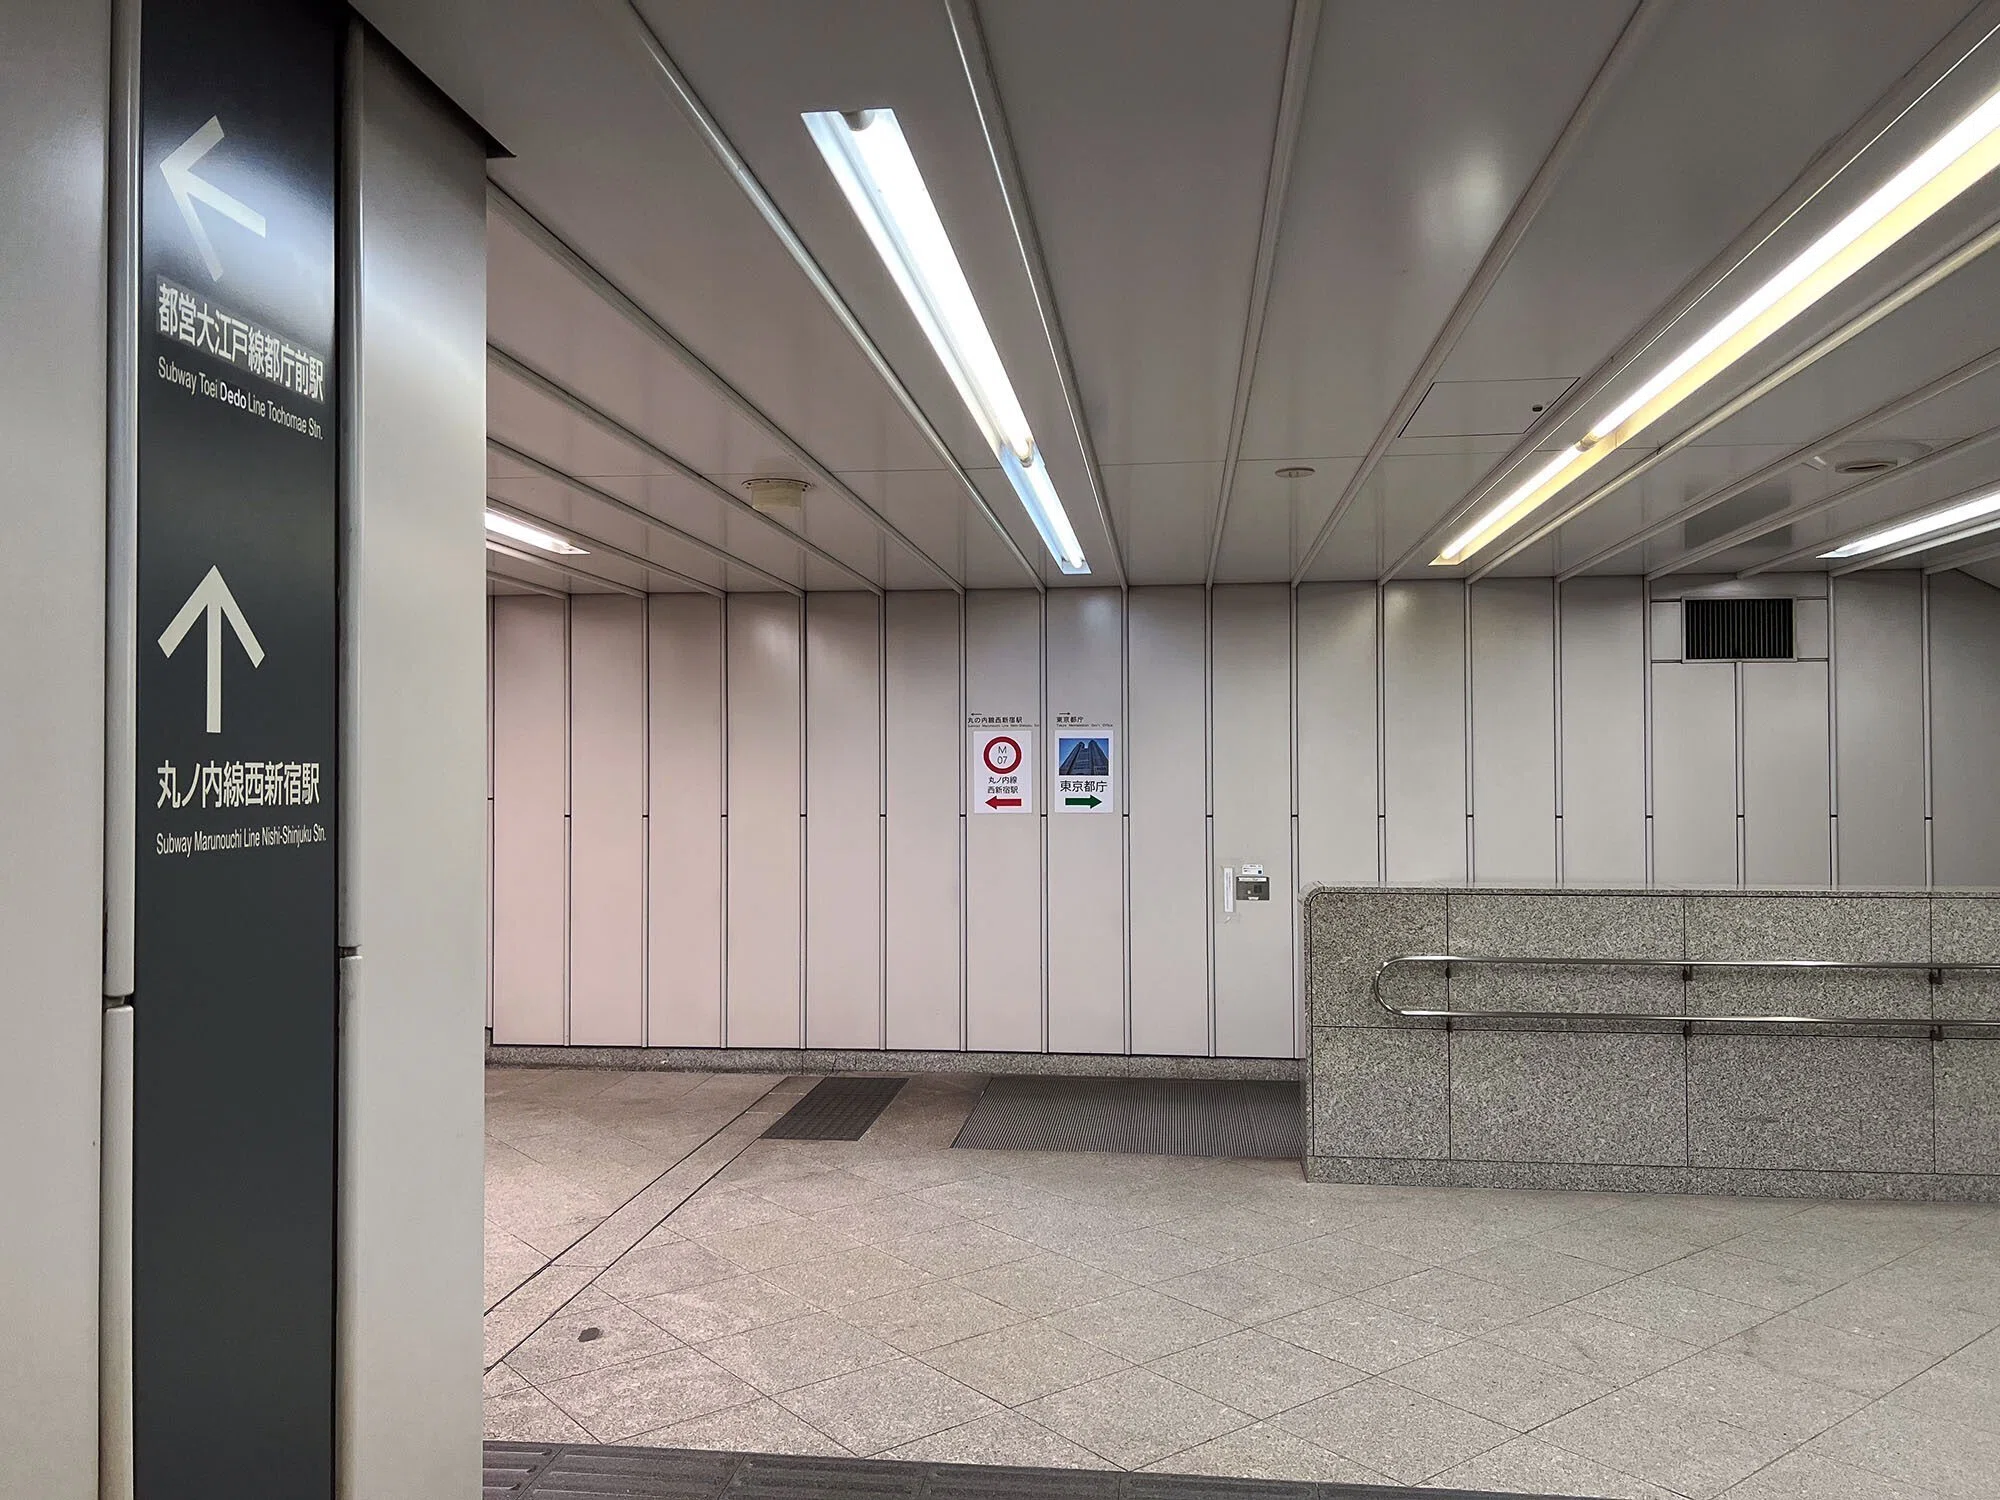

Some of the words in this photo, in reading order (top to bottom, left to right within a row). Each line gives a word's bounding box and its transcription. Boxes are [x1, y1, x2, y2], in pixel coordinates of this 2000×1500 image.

[158, 283, 324, 401] 都営大江戸線都庁前駅
[158, 356, 197, 395] Subway
[199, 372, 218, 398] Toei
[248, 392, 266, 417] Line
[267, 400, 307, 433] Tochomae
[308, 417, 324, 440] Stn.
[998, 746, 1007, 754] M
[997, 755, 1008, 765] 07
[157, 760, 320, 809] 丸ノ内線西新宿駅
[988, 776, 1018, 784] 丸ノ内線
[1060, 780, 1107, 793] 東京都庁
[987, 785, 1019, 794] 西新宿駅
[156, 832, 192, 858] Subway
[194, 829, 242, 852] Marunouchi
[244, 828, 260, 848] Line
[262, 825, 312, 848] Nishi-Shinjuku
[313, 823, 327, 842] Stn.
